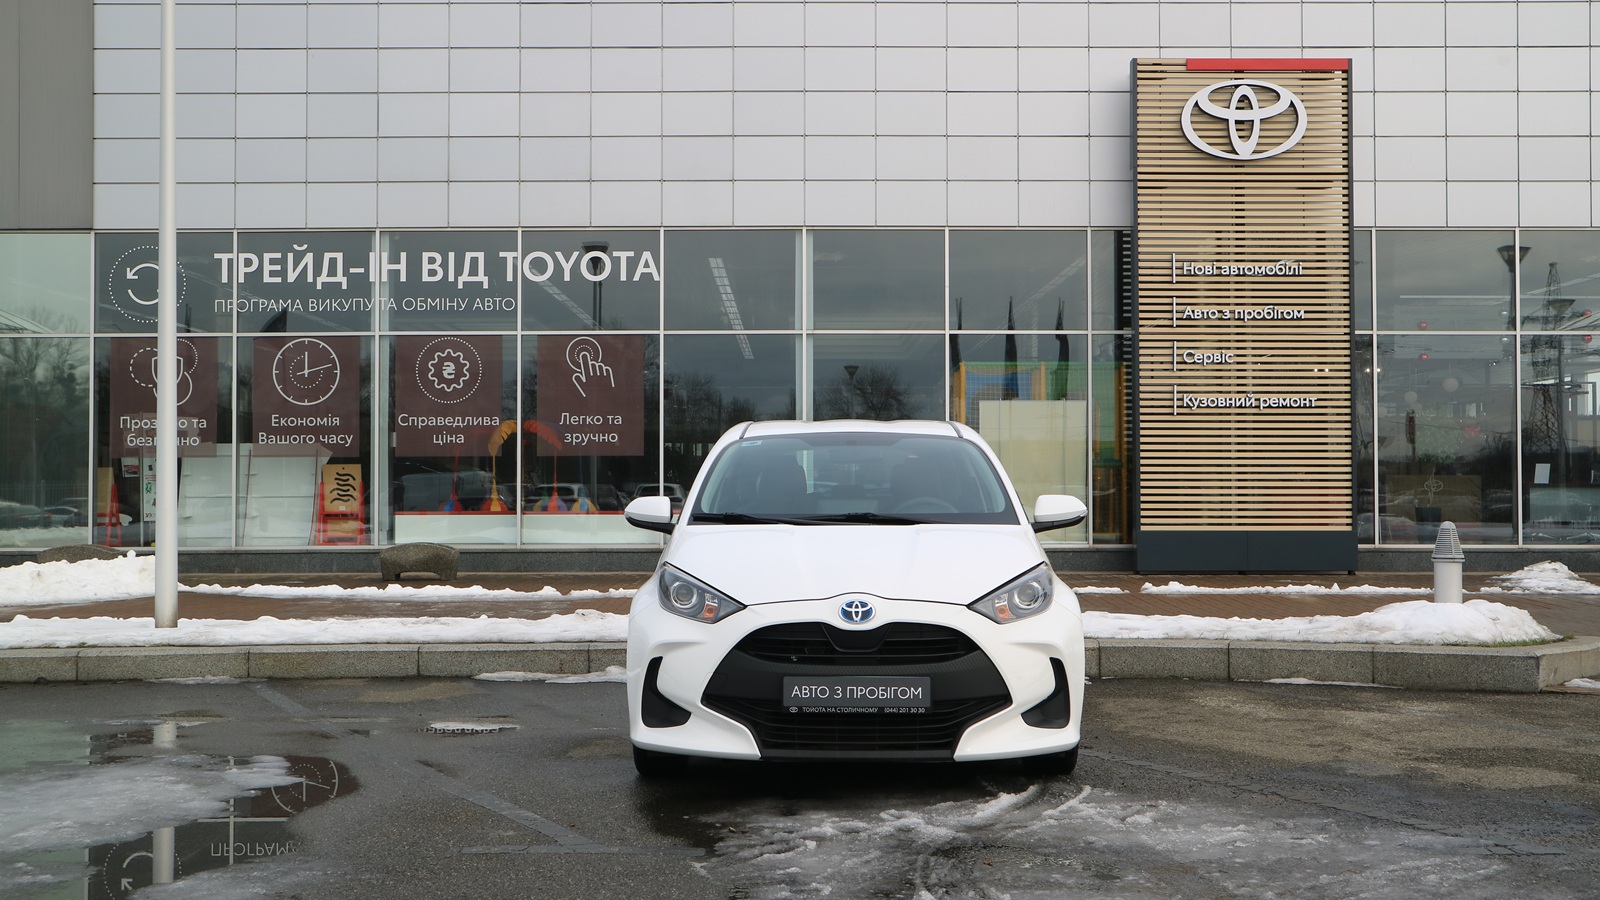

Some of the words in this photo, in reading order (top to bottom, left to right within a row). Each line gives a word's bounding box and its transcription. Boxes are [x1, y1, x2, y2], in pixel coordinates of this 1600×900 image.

[213, 243, 407, 290] ТРЕЙД-ІН
[421, 251, 489, 290] ВІД
[498, 251, 660, 283] TOYOTA
[1182, 261, 1217, 276] Нові
[1220, 260, 1303, 276] автомобілі
[214, 299, 304, 313] ПРОГРАМА
[308, 298, 375, 312] ВИКУПУ
[379, 297, 398, 311] ТА
[402, 297, 469, 312] ОБМІНУ
[472, 297, 516, 311] АВТО
[1182, 305, 1219, 319] Авто
[1221, 309, 1231, 319] з
[1234, 305, 1305, 322] пробігом
[1182, 349, 1234, 366] Сервіс
[1182, 393, 1256, 411] Кузовний
[1259, 396, 1318, 411] ремонт
[119, 416, 188, 432] Прозо
[191, 418, 207, 429] та
[271, 413, 340, 427] Економія
[397, 413, 500, 429] Справедлива
[559, 412, 603, 425] Легко
[606, 415, 622, 425] та
[258, 431, 316, 444] Вашого
[319, 434, 354, 447] часу
[432, 431, 465, 446] ціна
[563, 432, 619, 446] зручно
[791, 685, 830, 698] АВТО
[833, 686, 843, 699] З
[846, 686, 922, 699] ПРОБІГОМ
